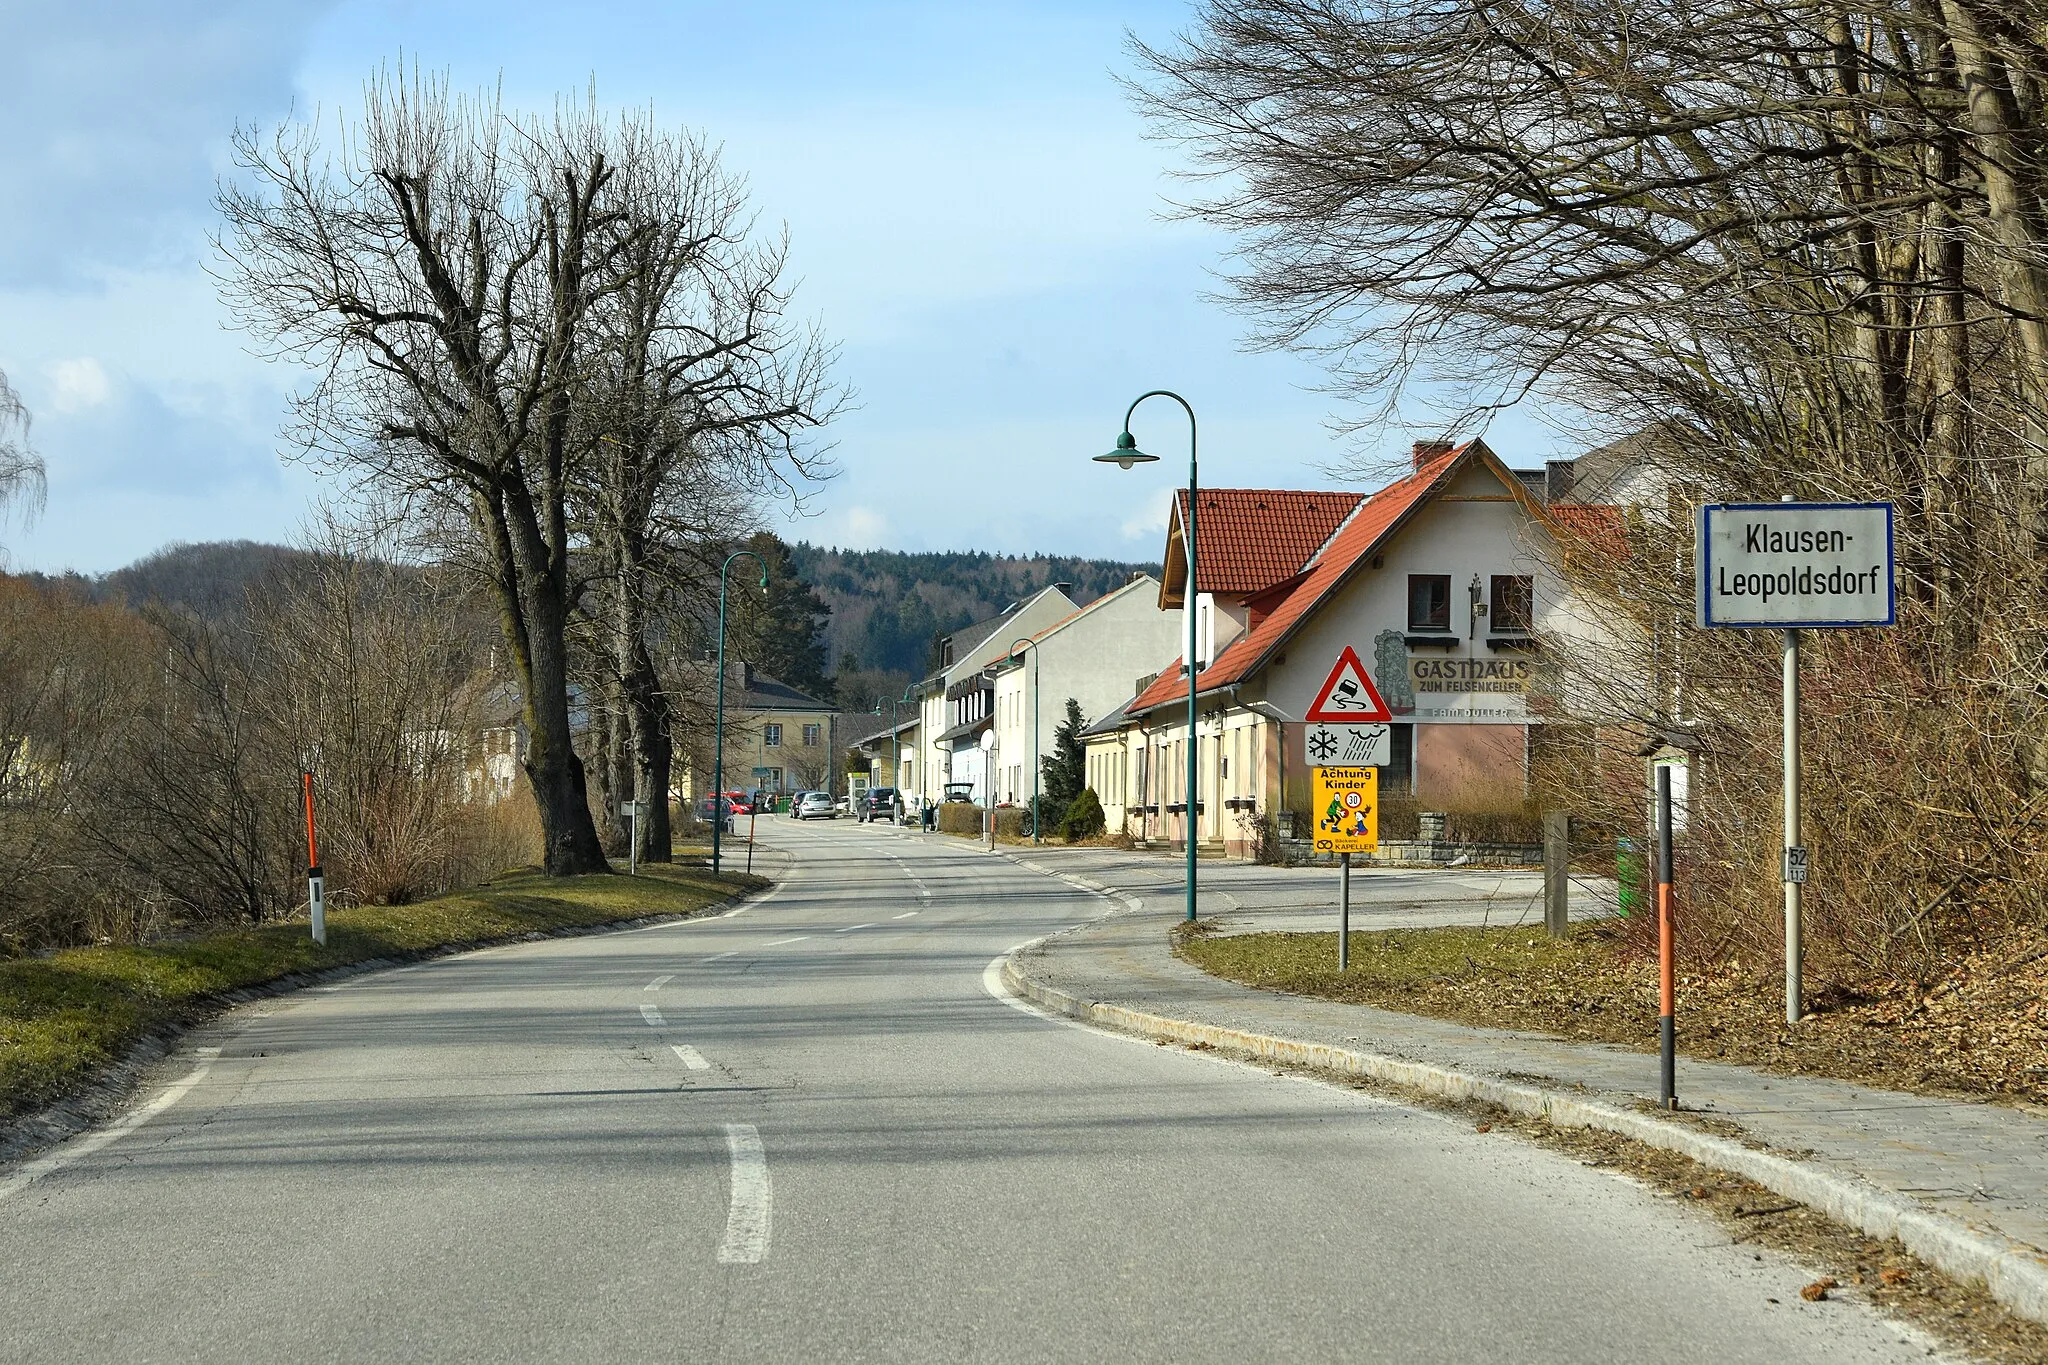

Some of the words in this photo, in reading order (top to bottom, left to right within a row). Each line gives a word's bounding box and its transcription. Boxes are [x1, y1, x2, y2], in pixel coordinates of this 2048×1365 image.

[1746, 523, 1853, 554] Klausen-
[1719, 565, 1880, 604] Leopoldsdorf
[1413, 657, 1529, 680] GASTHAUS
[1419, 681, 1443, 693] ZUM
[1446, 680, 1522, 693] FELSENKELLER
[1320, 768, 1372, 780] Achtung
[1325, 780, 1366, 789] Kinder
[1348, 795, 1358, 805] 30
[1790, 848, 1807, 866] 52
[1790, 869, 1806, 881] 113
